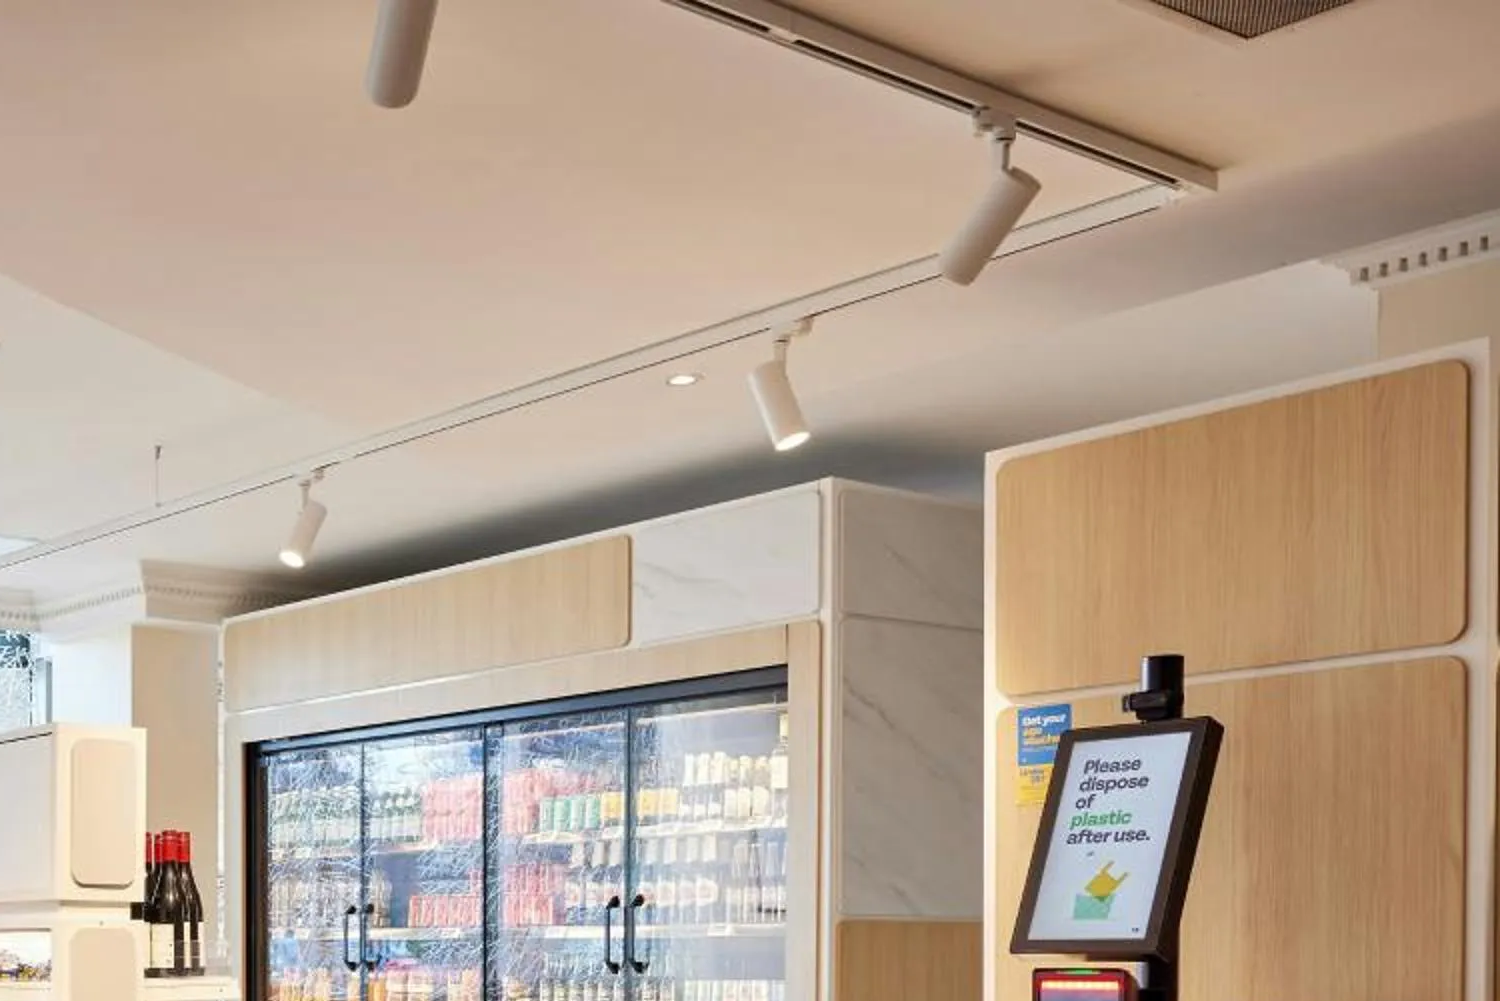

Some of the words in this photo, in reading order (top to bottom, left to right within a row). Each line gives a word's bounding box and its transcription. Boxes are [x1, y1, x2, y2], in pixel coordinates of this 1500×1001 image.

[1084, 759, 1142, 774] Please
[1079, 776, 1150, 794] dispose
[1075, 794, 1096, 810] of
[1069, 810, 1132, 831] plastic
[1066, 829, 1112, 845] after
[1113, 829, 1151, 843] use.
